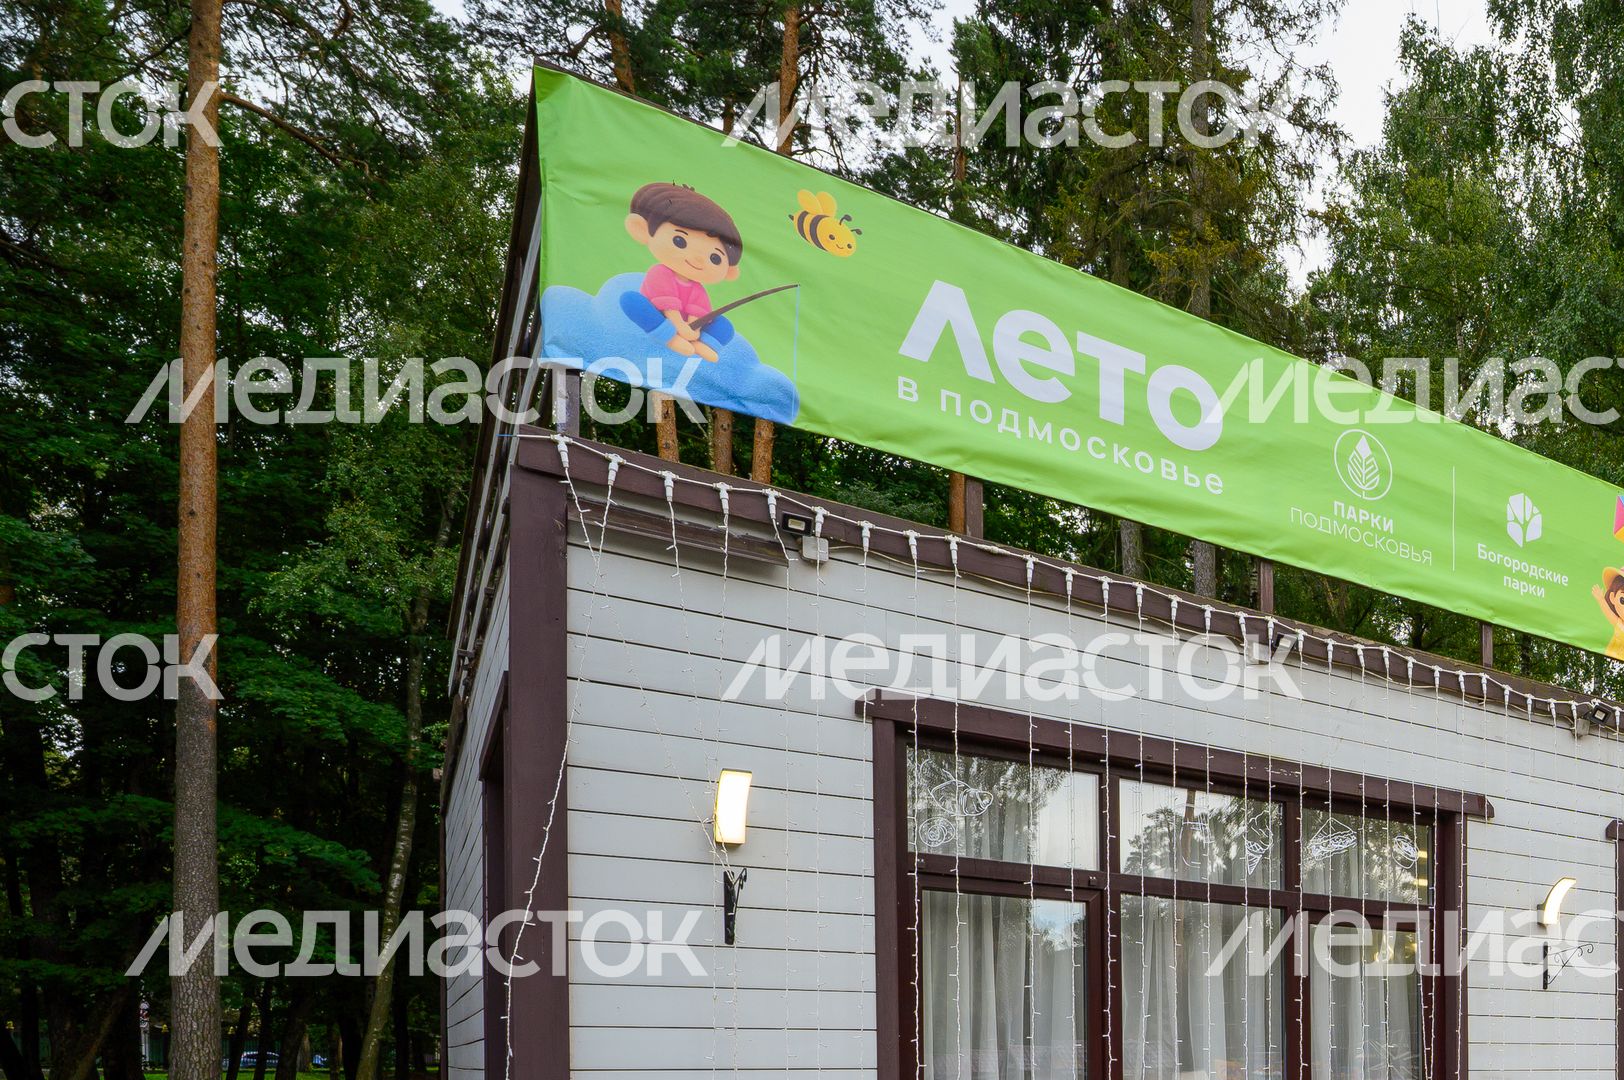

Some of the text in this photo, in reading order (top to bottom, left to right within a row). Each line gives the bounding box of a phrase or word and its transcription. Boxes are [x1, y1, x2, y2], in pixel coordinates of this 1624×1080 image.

[1290, 506, 1433, 566] ПОДМОСКОВЬЯ
[1333, 500, 1394, 534] ПАРКИ
[1477, 542, 1569, 588] Богородские
[1503, 573, 1546, 599] парки
